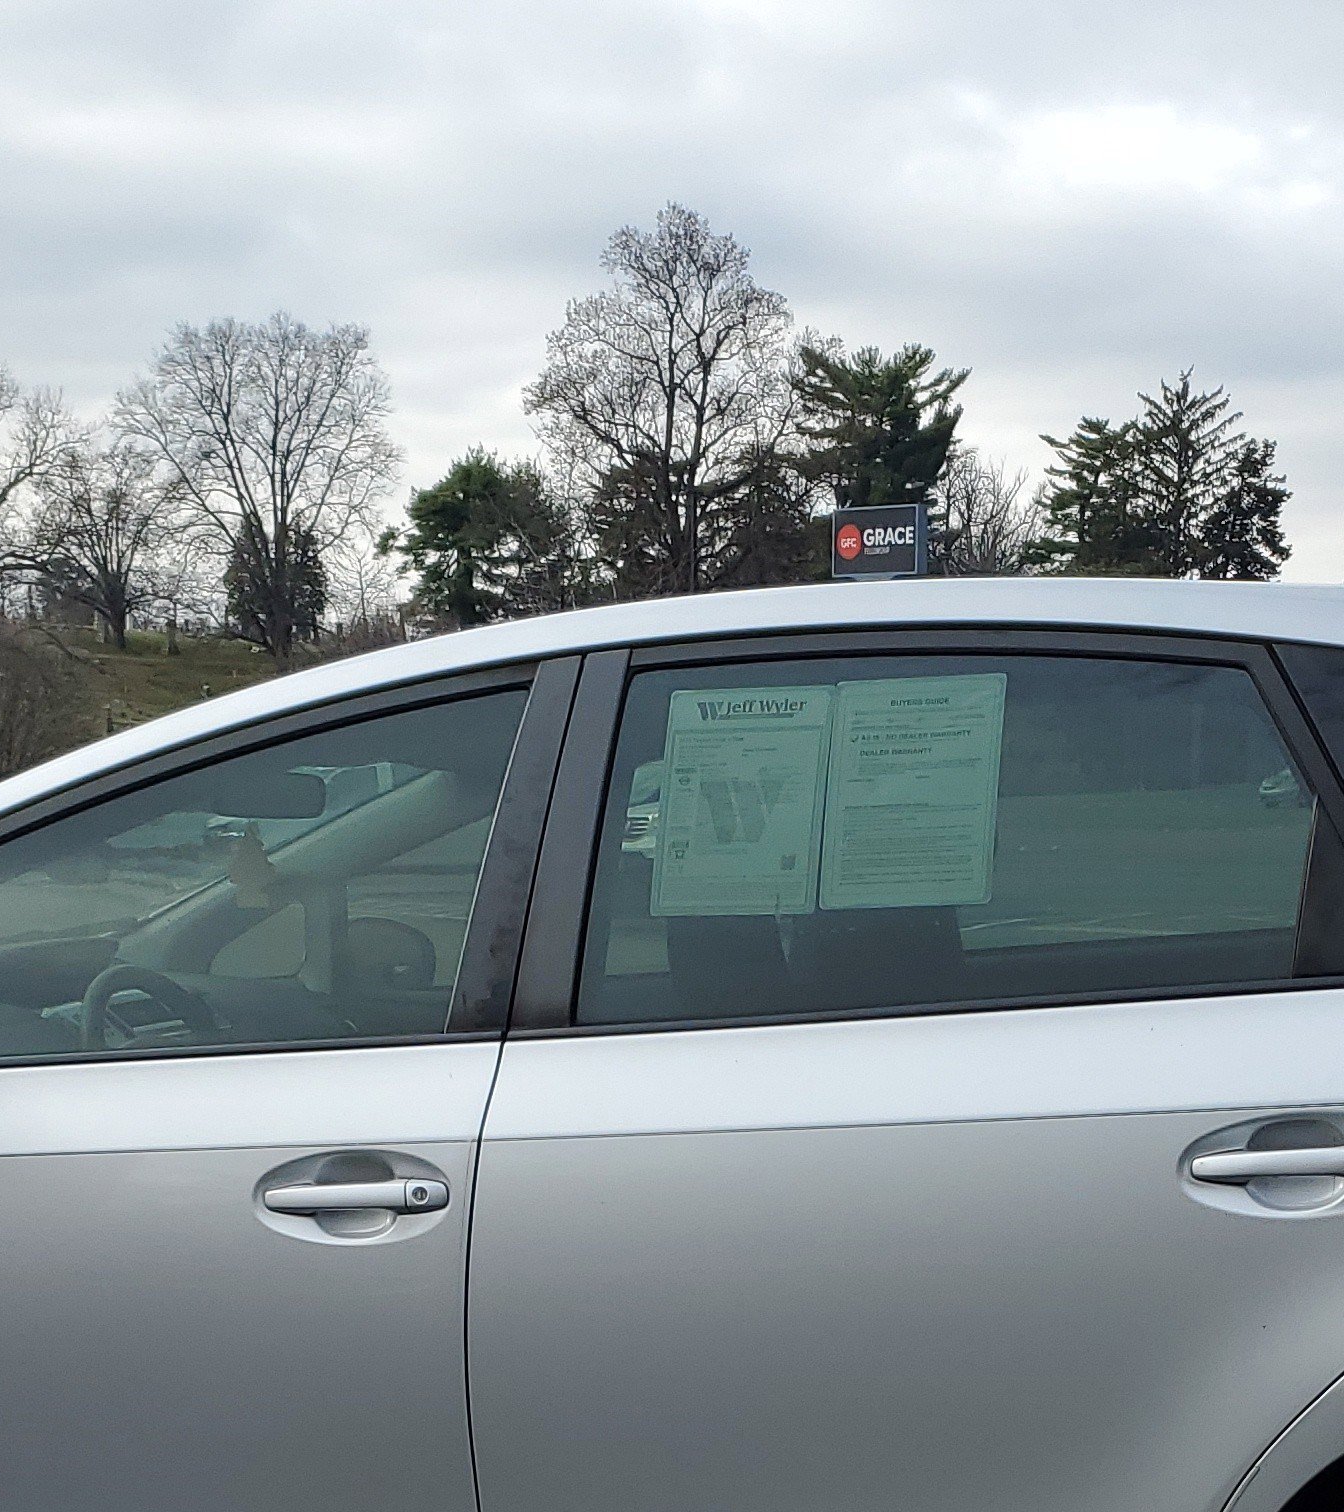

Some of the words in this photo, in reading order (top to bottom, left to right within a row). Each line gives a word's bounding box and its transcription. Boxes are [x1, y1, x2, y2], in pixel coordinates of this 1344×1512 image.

[863, 526, 915, 546] GRACE
[726, 700, 756, 715] Jeff
[759, 699, 808, 714] Wyler
